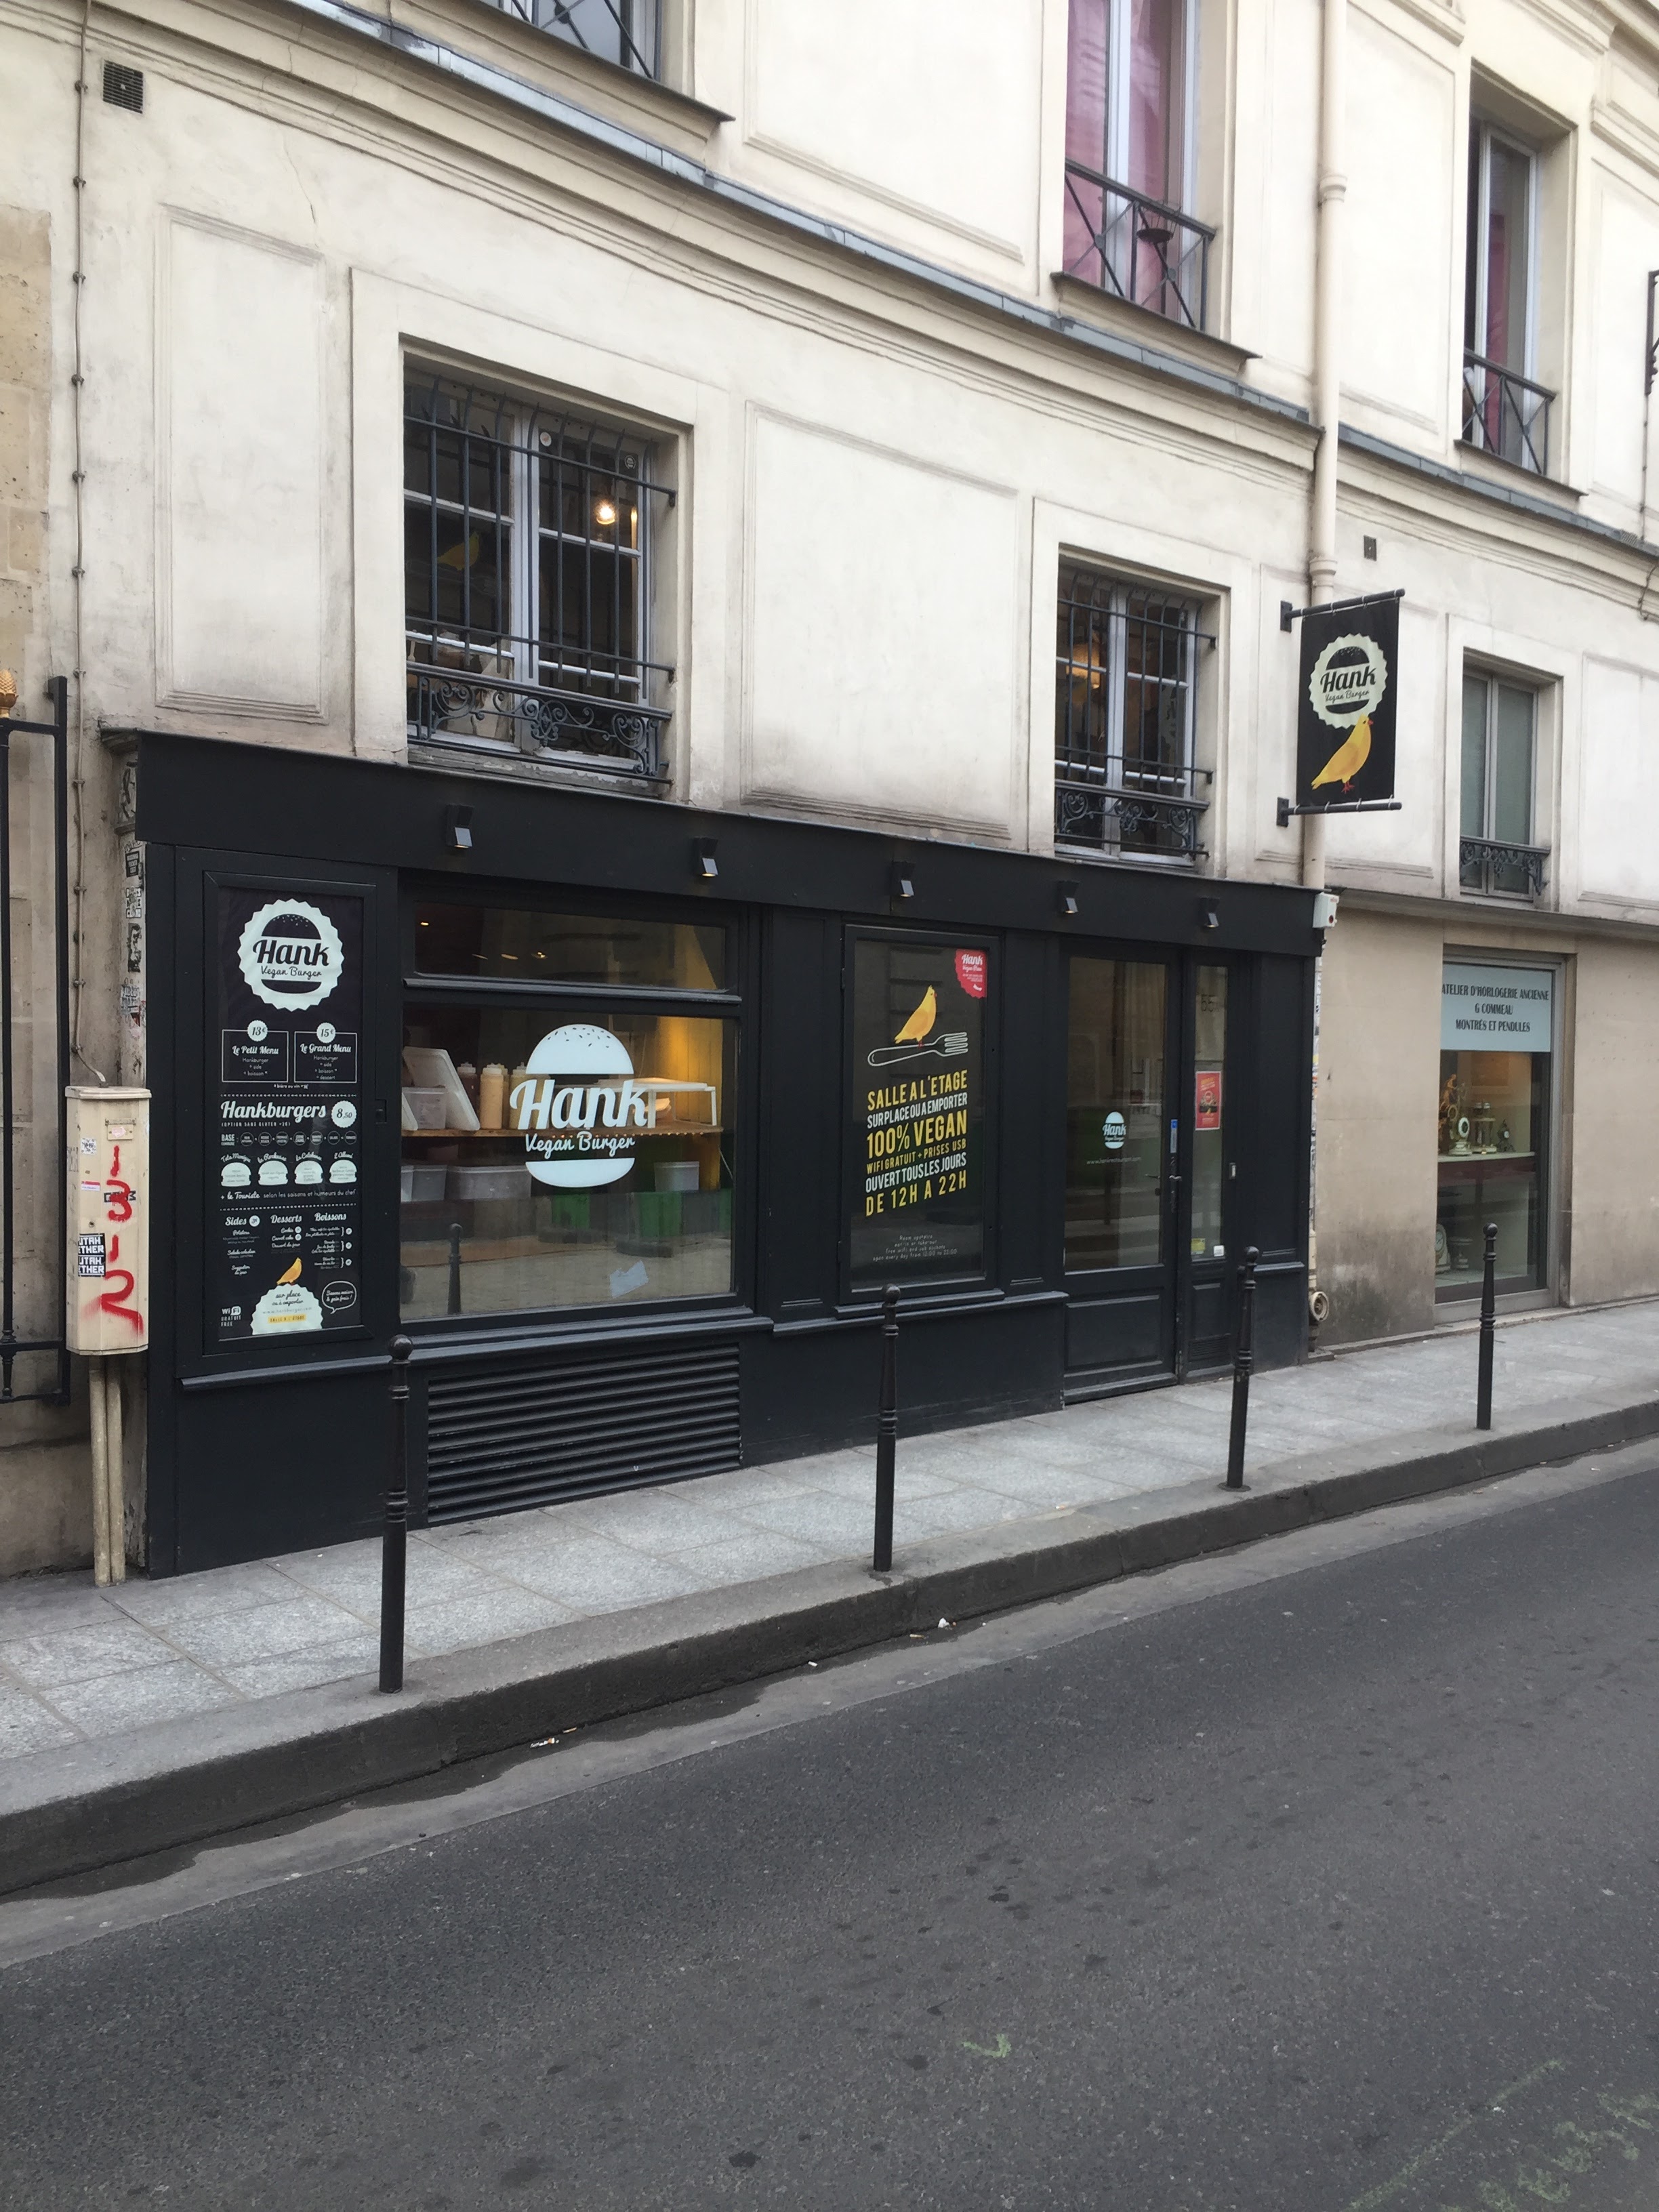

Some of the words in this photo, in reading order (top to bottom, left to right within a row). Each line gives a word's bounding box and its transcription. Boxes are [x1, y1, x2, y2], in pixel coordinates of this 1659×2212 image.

[1320, 665, 1376, 693] Hank
[1326, 693, 1344, 703] Vegan
[1345, 690, 1370, 700] Burger
[253, 939, 330, 967] Hank
[962, 954, 983, 965] Hank
[261, 966, 287, 978] Vegan
[289, 966, 322, 980] Burger
[1441, 983, 1469, 996] ATELIER
[1470, 985, 1518, 999] D'HORLOGERIE
[1519, 989, 1549, 1001] ANCIENNE
[1488, 1021, 1496, 1031] ET
[1498, 1021, 1530, 1032] PENDULES
[232, 1045, 240, 1056] Le
[241, 1046, 258, 1054] Petit
[259, 1046, 279, 1054] Menu
[300, 1043, 308, 1054] Le
[308, 1044, 331, 1053] Grand
[332, 1044, 352, 1053] Menu
[867, 1084, 907, 1111] SALLE
[909, 1081, 918, 1101] A
[920, 1069, 968, 1099] L'ETAGE
[220, 1101, 327, 1123] Hankburgers
[510, 1079, 647, 1130] Hank
[867, 1112, 884, 1129] SUR
[884, 1105, 909, 1125] PLACE
[909, 1102, 921, 1119] OU
[927, 1092, 968, 1114] EMPORTER
[867, 1122, 910, 1159] 100%
[914, 1109, 967, 1147] VEGAN
[1103, 1124, 1127, 1136] Hank
[525, 1134, 574, 1159] Vegan
[577, 1131, 635, 1157] Burger
[866, 1158, 883, 1174] WIFI
[884, 1151, 916, 1170] GRATUIT
[924, 1142, 949, 1159] PRISES
[952, 1138, 966, 1151] USB
[865, 1169, 901, 1193] OUVERT
[901, 1163, 924, 1183] TOUS
[924, 1159, 940, 1177] LES
[940, 1151, 967, 1172] JOURS
[234, 1191, 260, 1199] Touriste
[865, 1192, 884, 1217] DE
[891, 1183, 918, 1209] 12H
[924, 1179, 932, 1200] A
[939, 1169, 966, 1195] 22H
[225, 1216, 247, 1226] Sides
[270, 1214, 302, 1224] Desserts
[314, 1212, 347, 1221] Boissons
[285, 1290, 301, 1300] place
